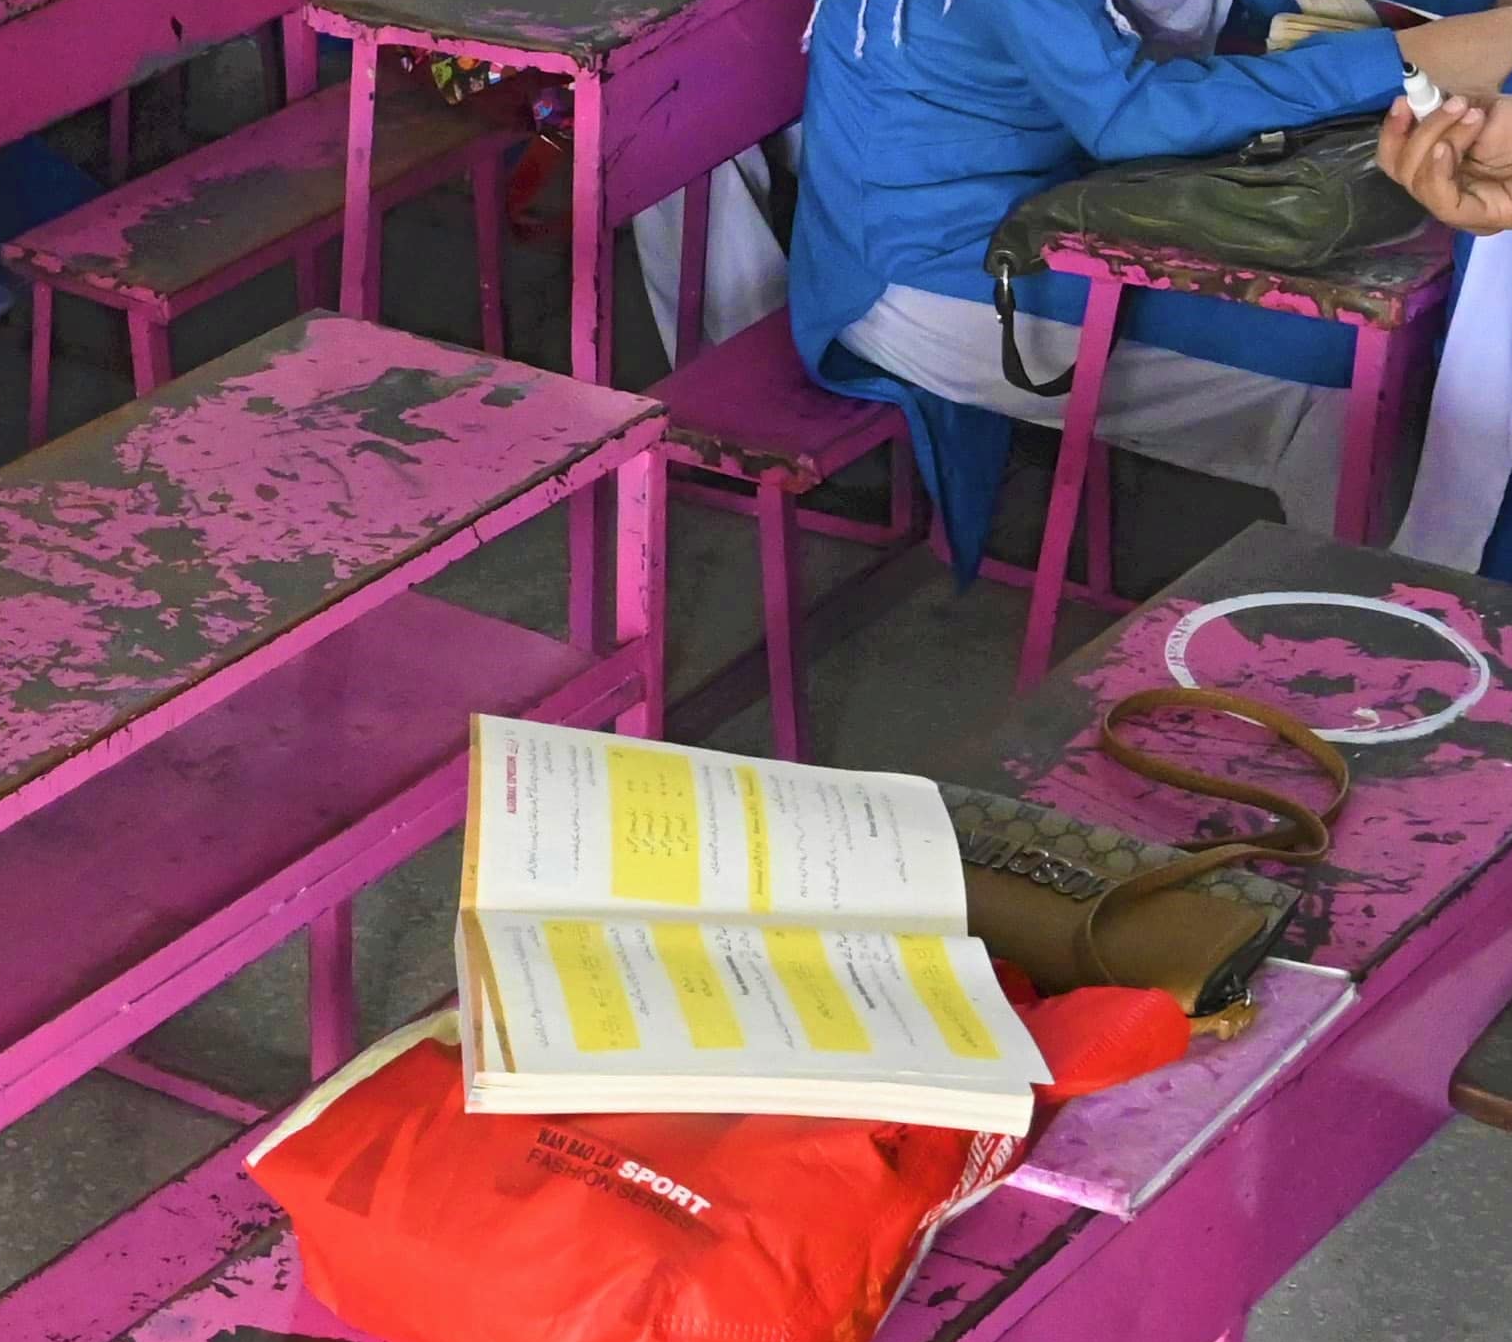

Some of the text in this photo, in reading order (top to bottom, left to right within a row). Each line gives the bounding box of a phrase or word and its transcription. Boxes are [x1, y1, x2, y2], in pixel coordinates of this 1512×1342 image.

[527, 1148, 691, 1229] FASHION SERIES
[537, 1127, 712, 1215] WAN BAO LAI SPORT
